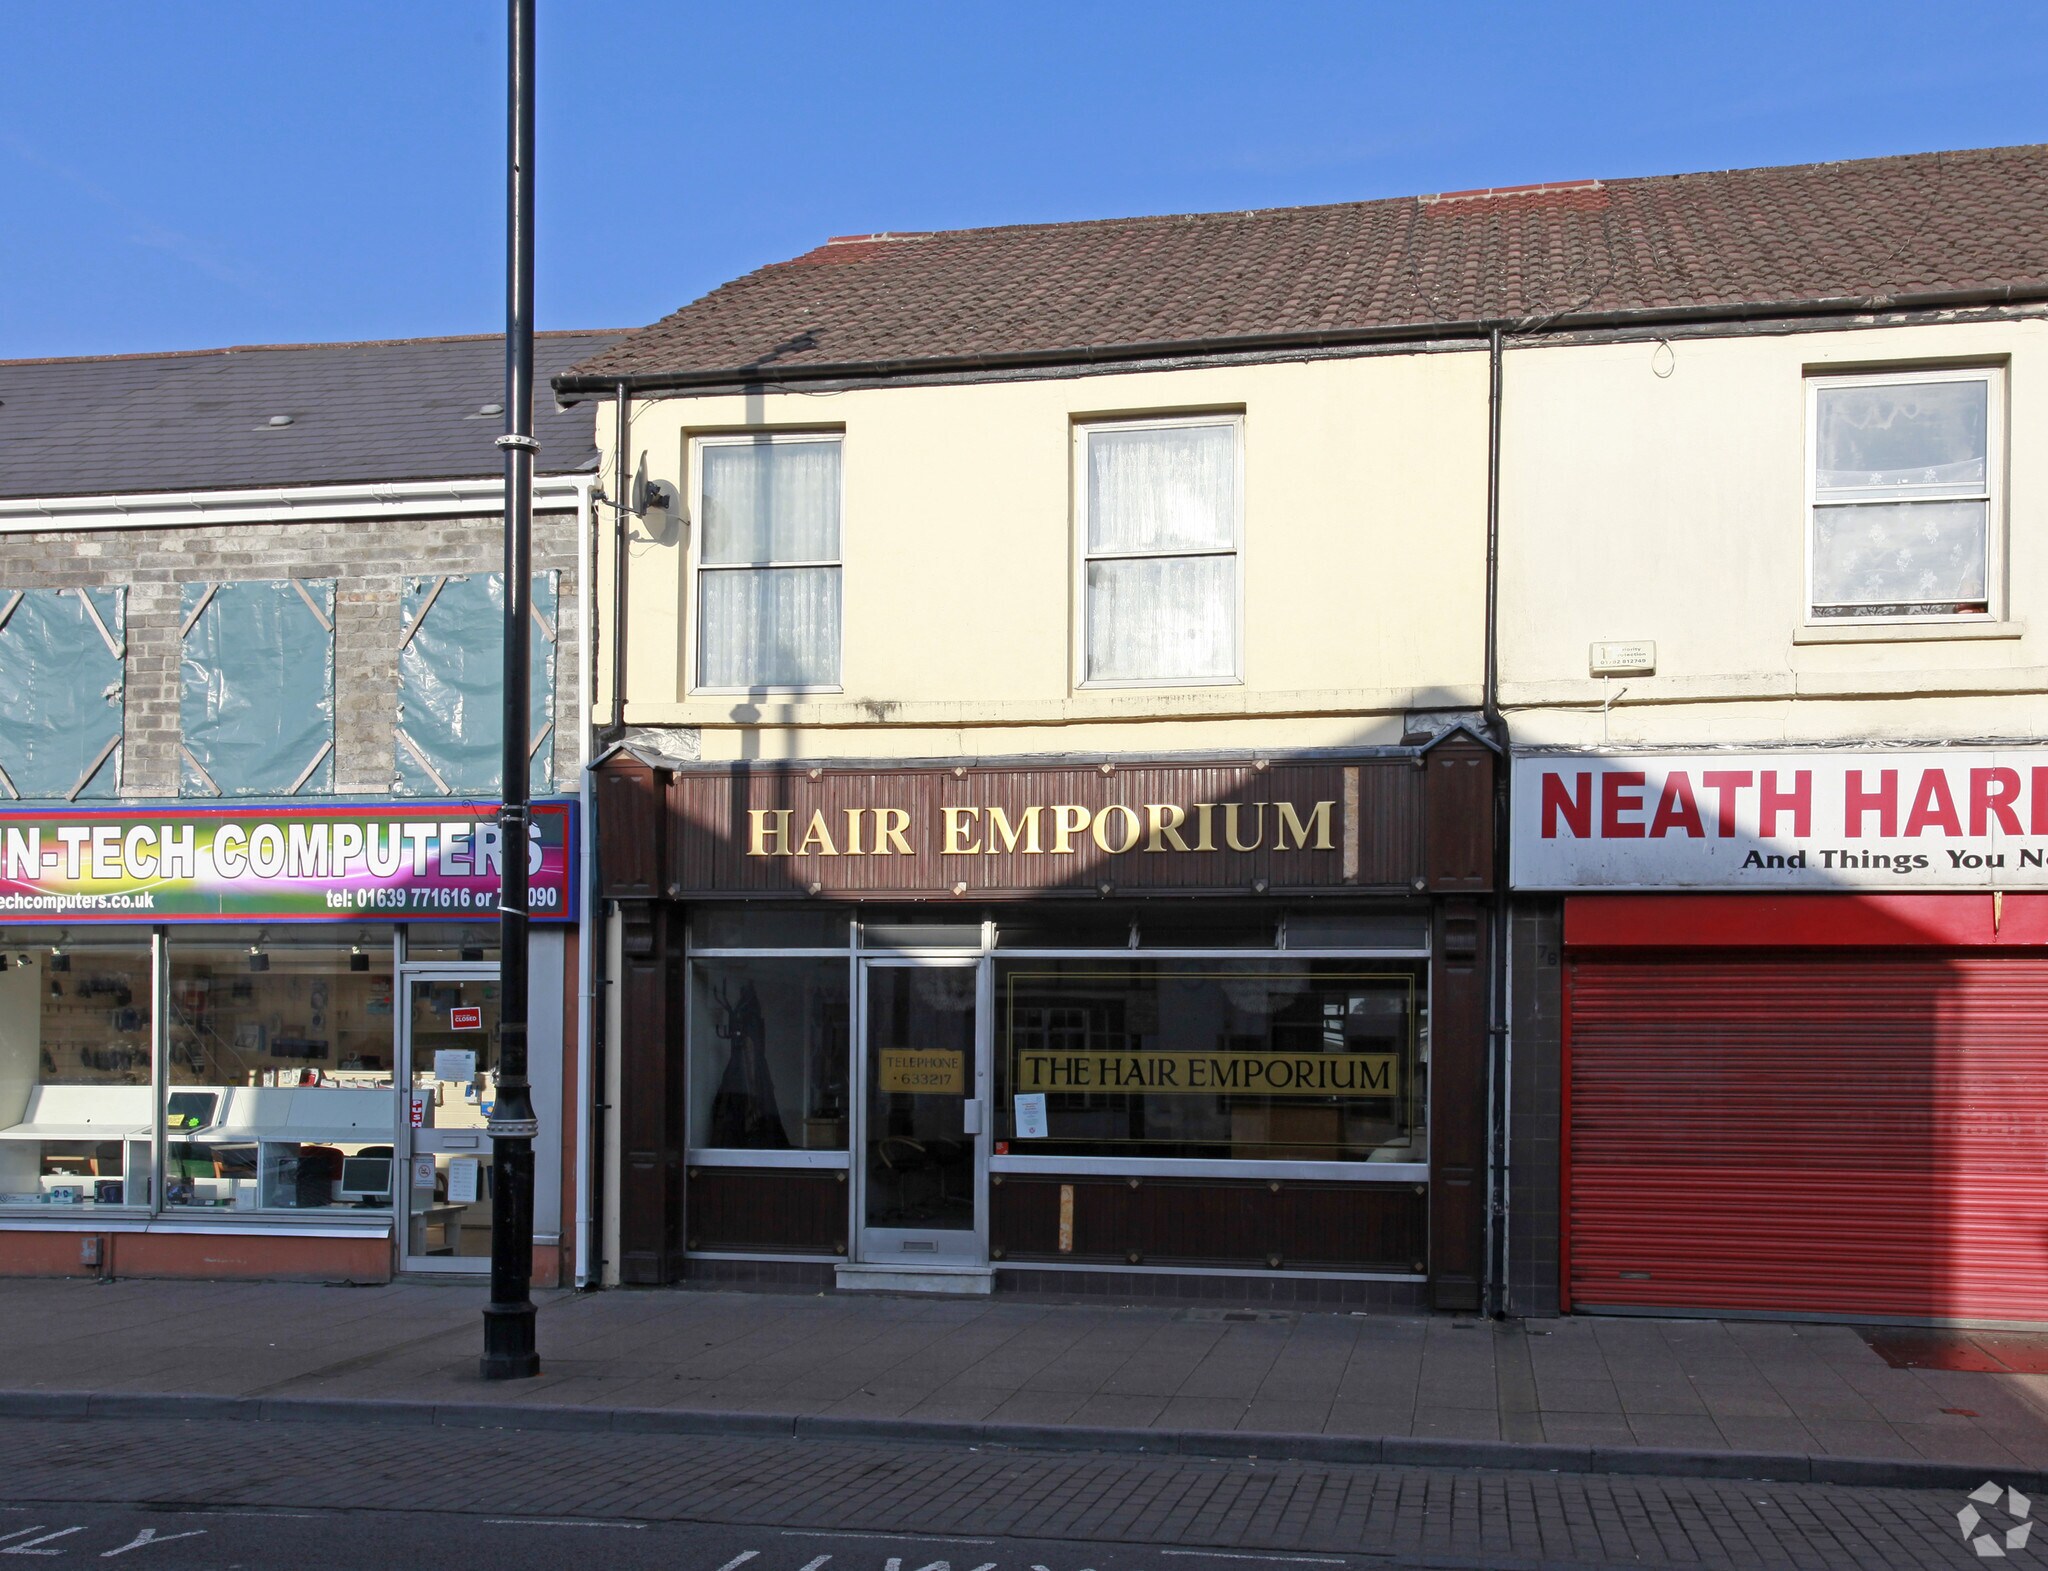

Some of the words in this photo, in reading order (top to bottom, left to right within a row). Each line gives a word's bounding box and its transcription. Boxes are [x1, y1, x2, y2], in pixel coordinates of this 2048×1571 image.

[1541, 770, 1812, 839] NEATH
[746, 808, 917, 856] HAIR
[940, 801, 1336, 855] EMPORIUM
[0, 824, 195, 879] N-TECH
[1741, 850, 1806, 869] And
[1819, 849, 1929, 874] Things
[1946, 849, 2005, 868] You
[326, 889, 352, 907] tel:
[357, 887, 405, 907] 01639
[411, 887, 470, 907] 771616
[475, 892, 492, 907] or
[455, 1015, 477, 1023] CLOSED
[887, 1057, 959, 1069] TELEPHONE
[1025, 1056, 1090, 1086] THE
[1099, 1057, 1177, 1087] HAIR
[1188, 1058, 1391, 1090] EMPORIUM
[901, 1074, 951, 1085] 633217
[413, 1100, 422, 1128] PUSH
